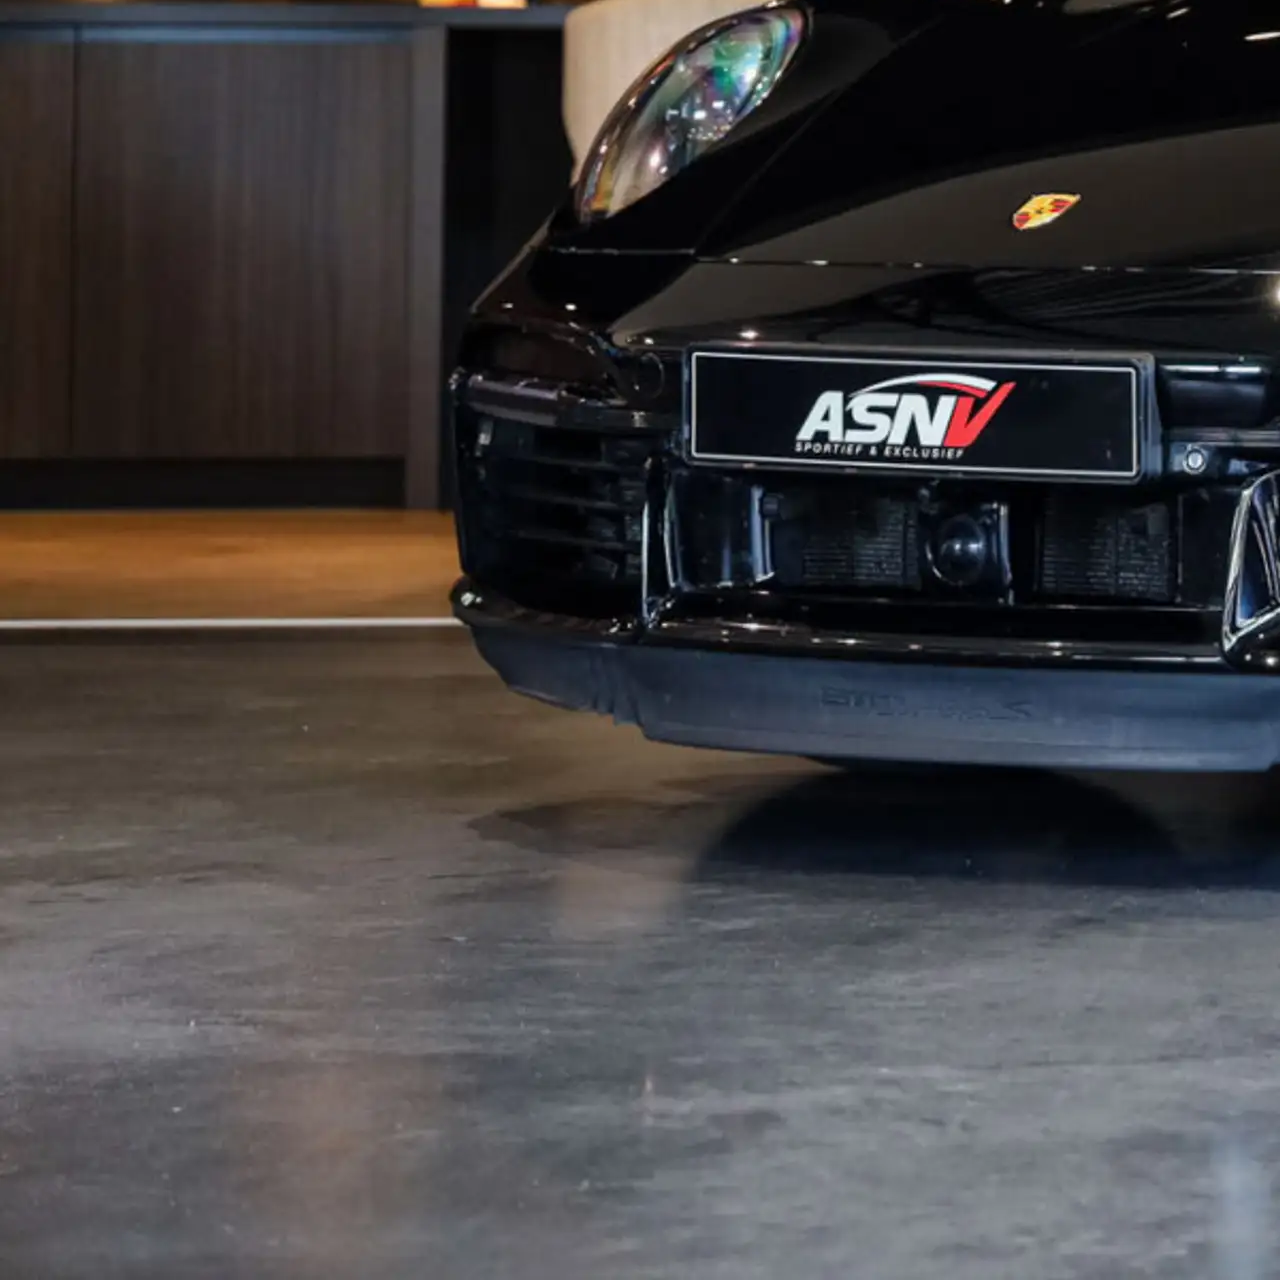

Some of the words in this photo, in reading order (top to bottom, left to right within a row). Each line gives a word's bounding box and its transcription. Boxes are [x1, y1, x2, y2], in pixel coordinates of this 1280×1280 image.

[795, 381, 1017, 447] ASNV
[795, 441, 863, 455] SPORTIEF
[868, 445, 879, 457] &
[884, 445, 965, 459] EXCLUSIEF
